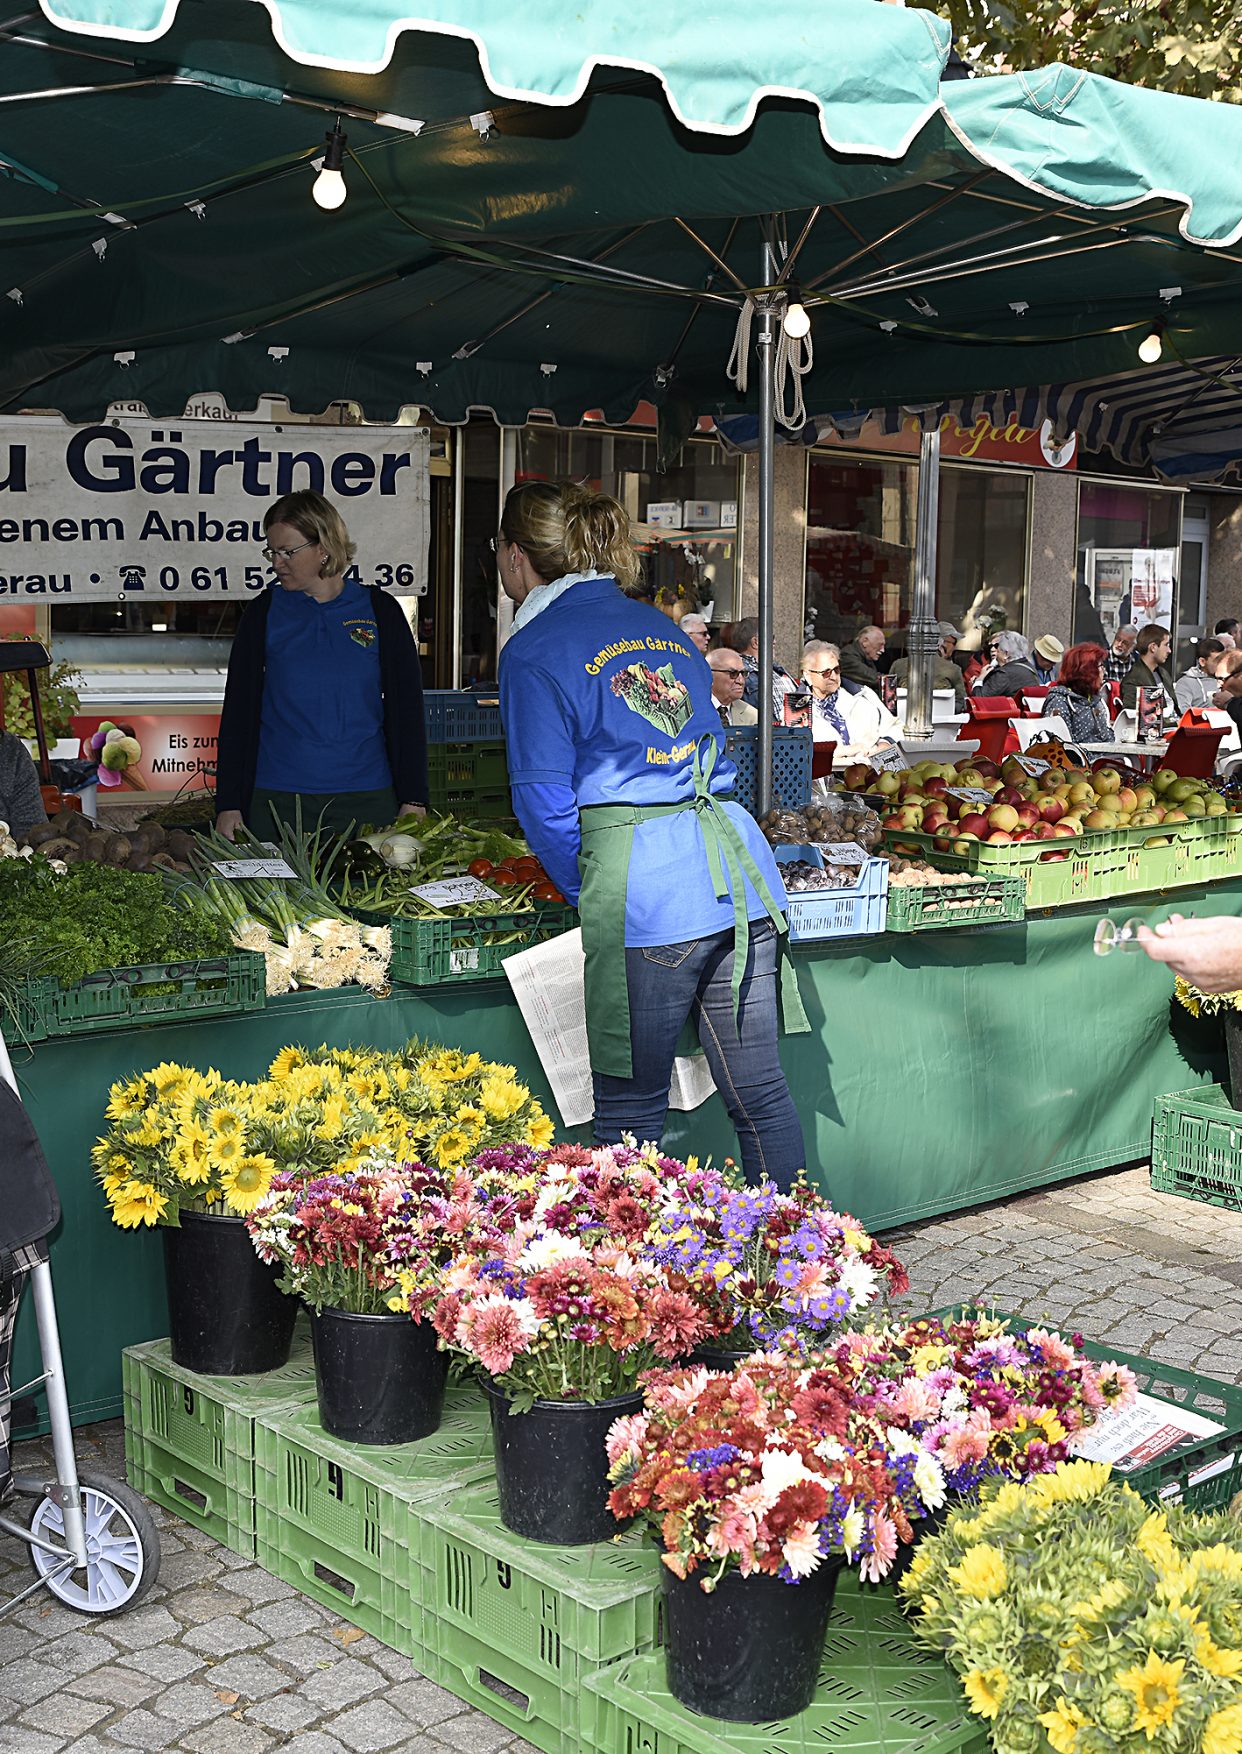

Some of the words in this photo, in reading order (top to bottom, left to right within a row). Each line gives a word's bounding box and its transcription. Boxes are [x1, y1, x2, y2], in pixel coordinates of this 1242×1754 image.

[66, 425, 411, 497] Gärtner
[0, 517, 125, 543] enem
[159, 566, 180, 591] 0
[191, 565, 229, 591] 61
[374, 563, 415, 588] 36
[584, 637, 646, 676] Gemüsebau
[169, 734, 188, 749] Eis
